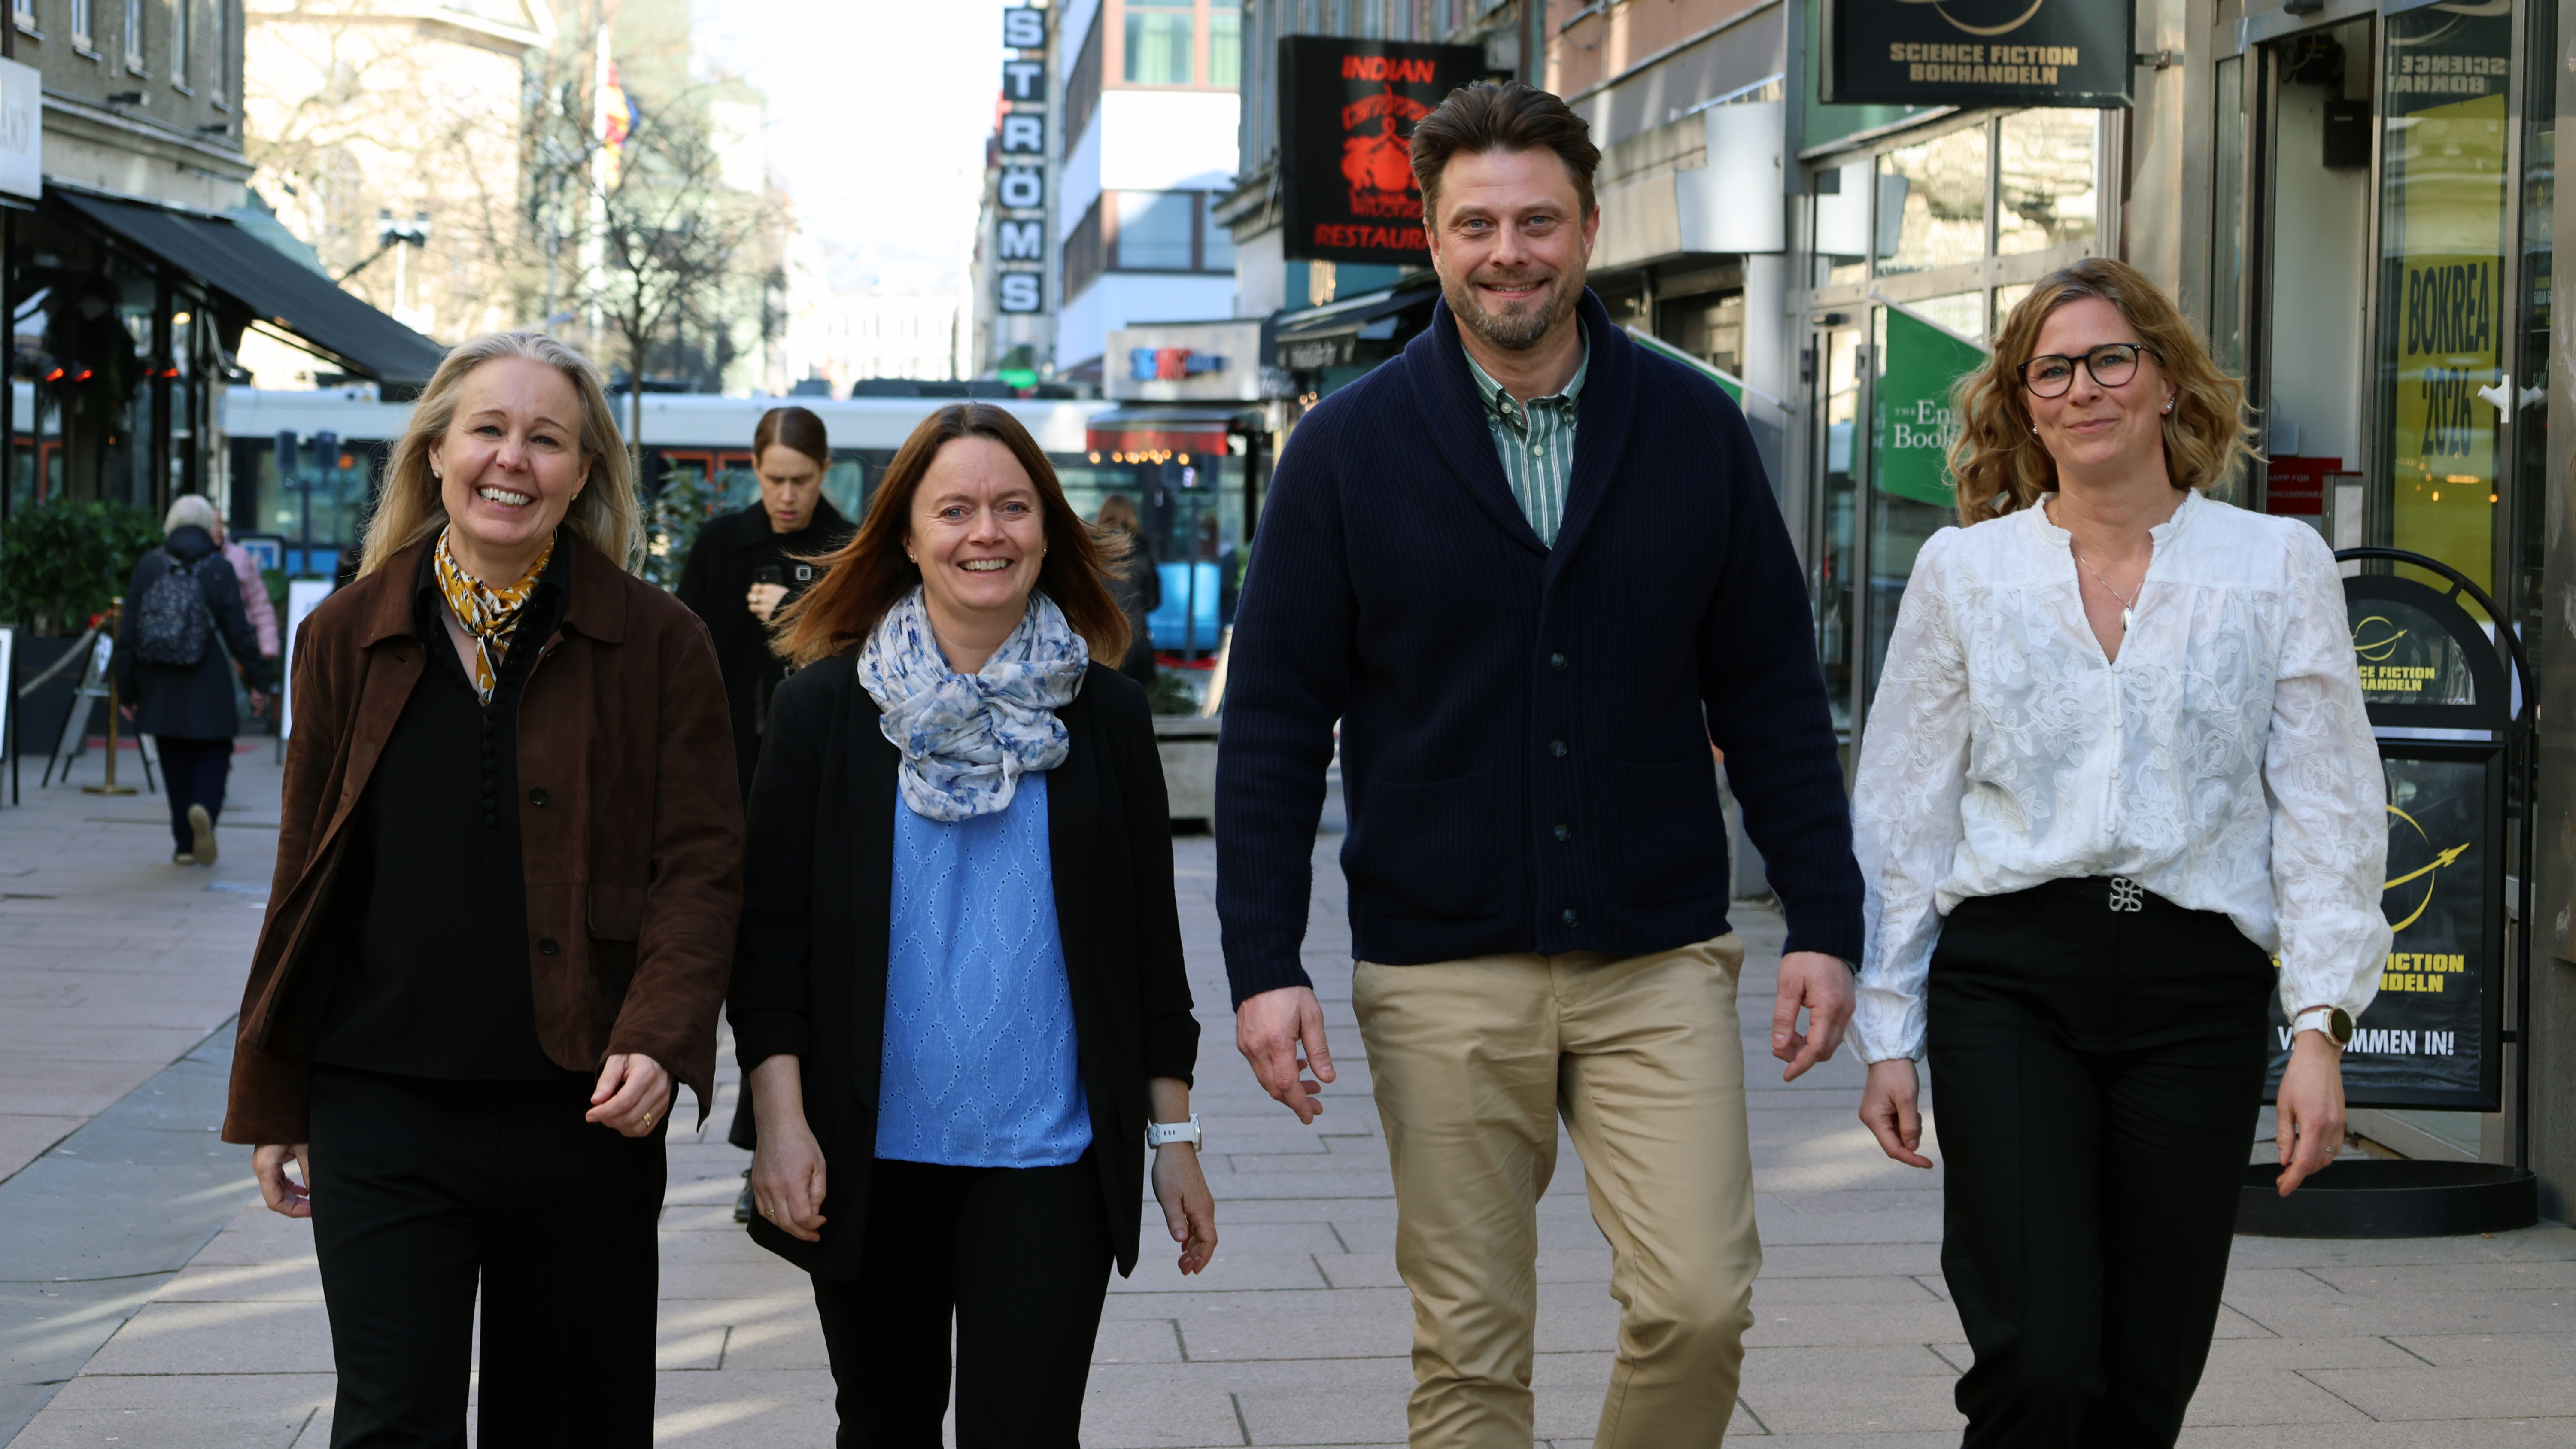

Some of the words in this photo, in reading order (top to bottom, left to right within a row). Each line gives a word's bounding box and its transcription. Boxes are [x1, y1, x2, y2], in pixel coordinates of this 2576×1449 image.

[1890, 42, 1984, 63] SCIENCE
[1990, 45, 2078, 66] FICTION
[1341, 54, 1436, 85] INDIAN
[1910, 63, 2058, 85] BOKHANDELN
[1001, 9, 1043, 312] STRÖMS
[1314, 222, 1429, 250] RESTAUR
[2408, 262, 2489, 355] BOKREA
[2421, 367, 2472, 457] 2026
[1893, 422, 1953, 449] Book
[2359, 665, 2375, 678] CE
[2379, 665, 2435, 679] FICTION
[2362, 678, 2422, 691] HANDELN
[2387, 952, 2464, 973] ICTION
[2379, 973, 2444, 993] NDELN
[2424, 1030, 2454, 1056] IN!
